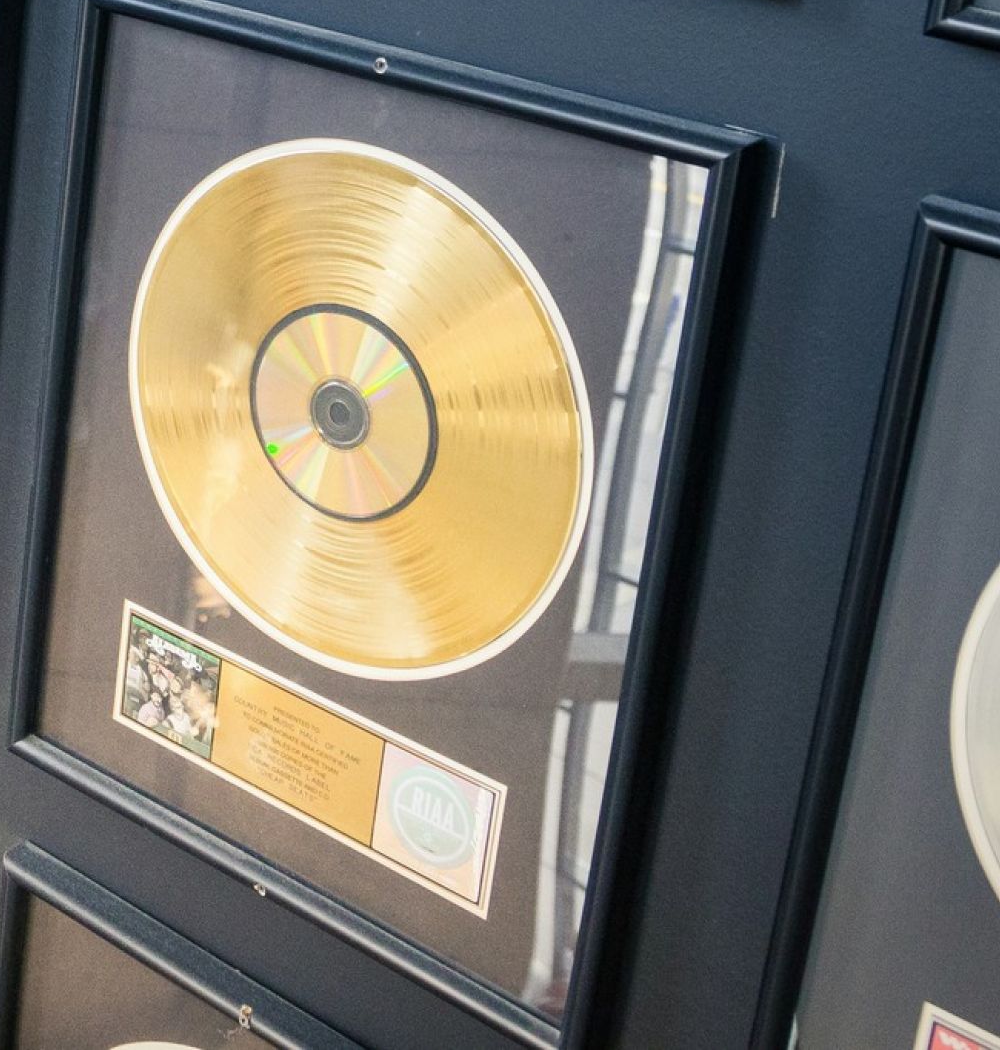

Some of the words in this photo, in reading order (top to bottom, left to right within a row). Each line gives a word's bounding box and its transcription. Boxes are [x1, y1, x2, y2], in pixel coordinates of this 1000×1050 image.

[233, 694, 267, 717] COUNTRY
[272, 714, 294, 731] MUSIC
[298, 727, 318, 743] HALL
[324, 741, 334, 751] OF
[339, 748, 360, 765] FAME
[305, 773, 330, 791] LABEL
[411, 786, 455, 830] RIAA
